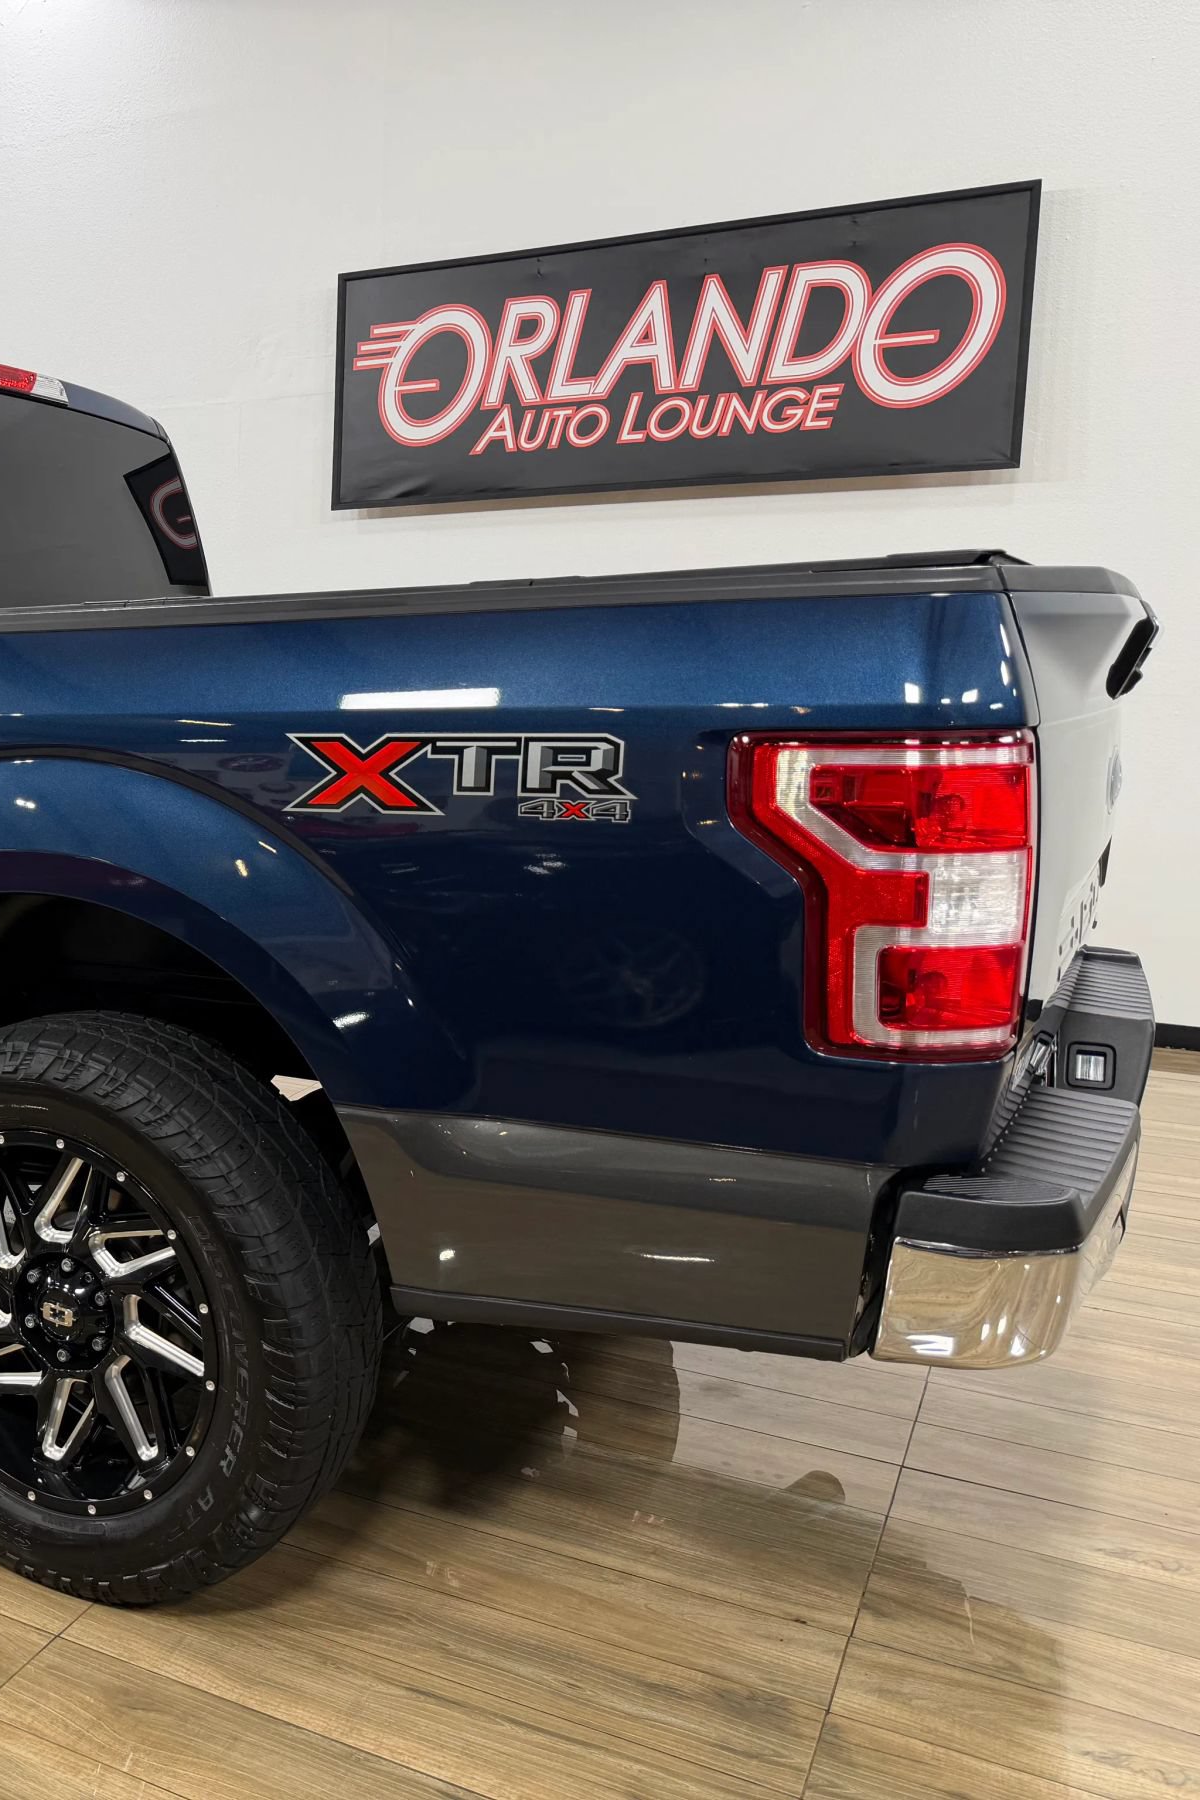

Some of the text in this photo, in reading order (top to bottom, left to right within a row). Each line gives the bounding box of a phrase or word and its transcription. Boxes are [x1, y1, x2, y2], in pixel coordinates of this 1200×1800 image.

[354, 242, 1007, 447] ORLANDO
[469, 383, 844, 456] AUTO LOUNGE
[281, 733, 638, 815] XTR
